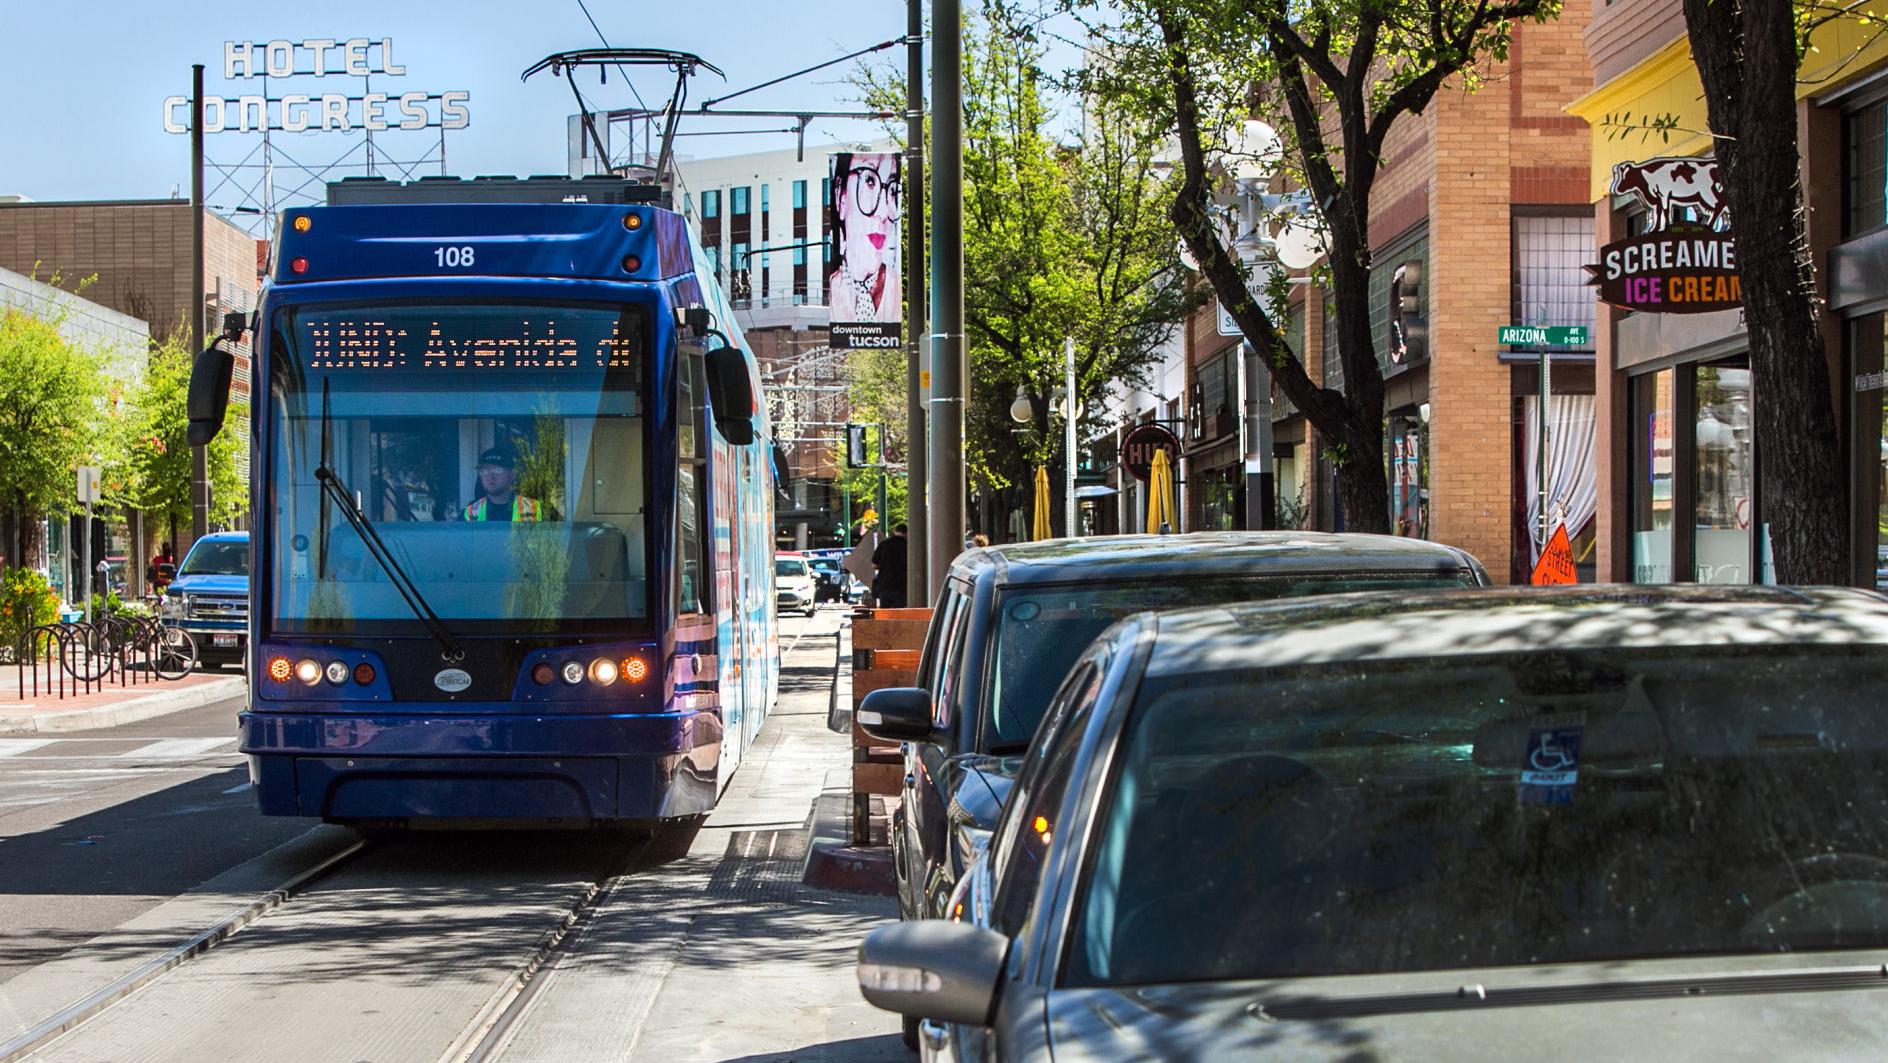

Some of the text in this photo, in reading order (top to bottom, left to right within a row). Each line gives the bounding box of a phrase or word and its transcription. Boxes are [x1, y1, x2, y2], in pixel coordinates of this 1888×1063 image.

[224, 37, 406, 79] HOTEL
[163, 90, 470, 133] CONGRESS
[434, 246, 475, 267] 108
[1606, 240, 1735, 280] SCREAME
[1625, 277, 1662, 304] ICE
[832, 325, 882, 334] downtown
[849, 334, 899, 347] tucson
[1502, 328, 1546, 343] ARIZONA
[1569, 327, 1579, 335] AVE
[425, 321, 577, 367] Avenida
